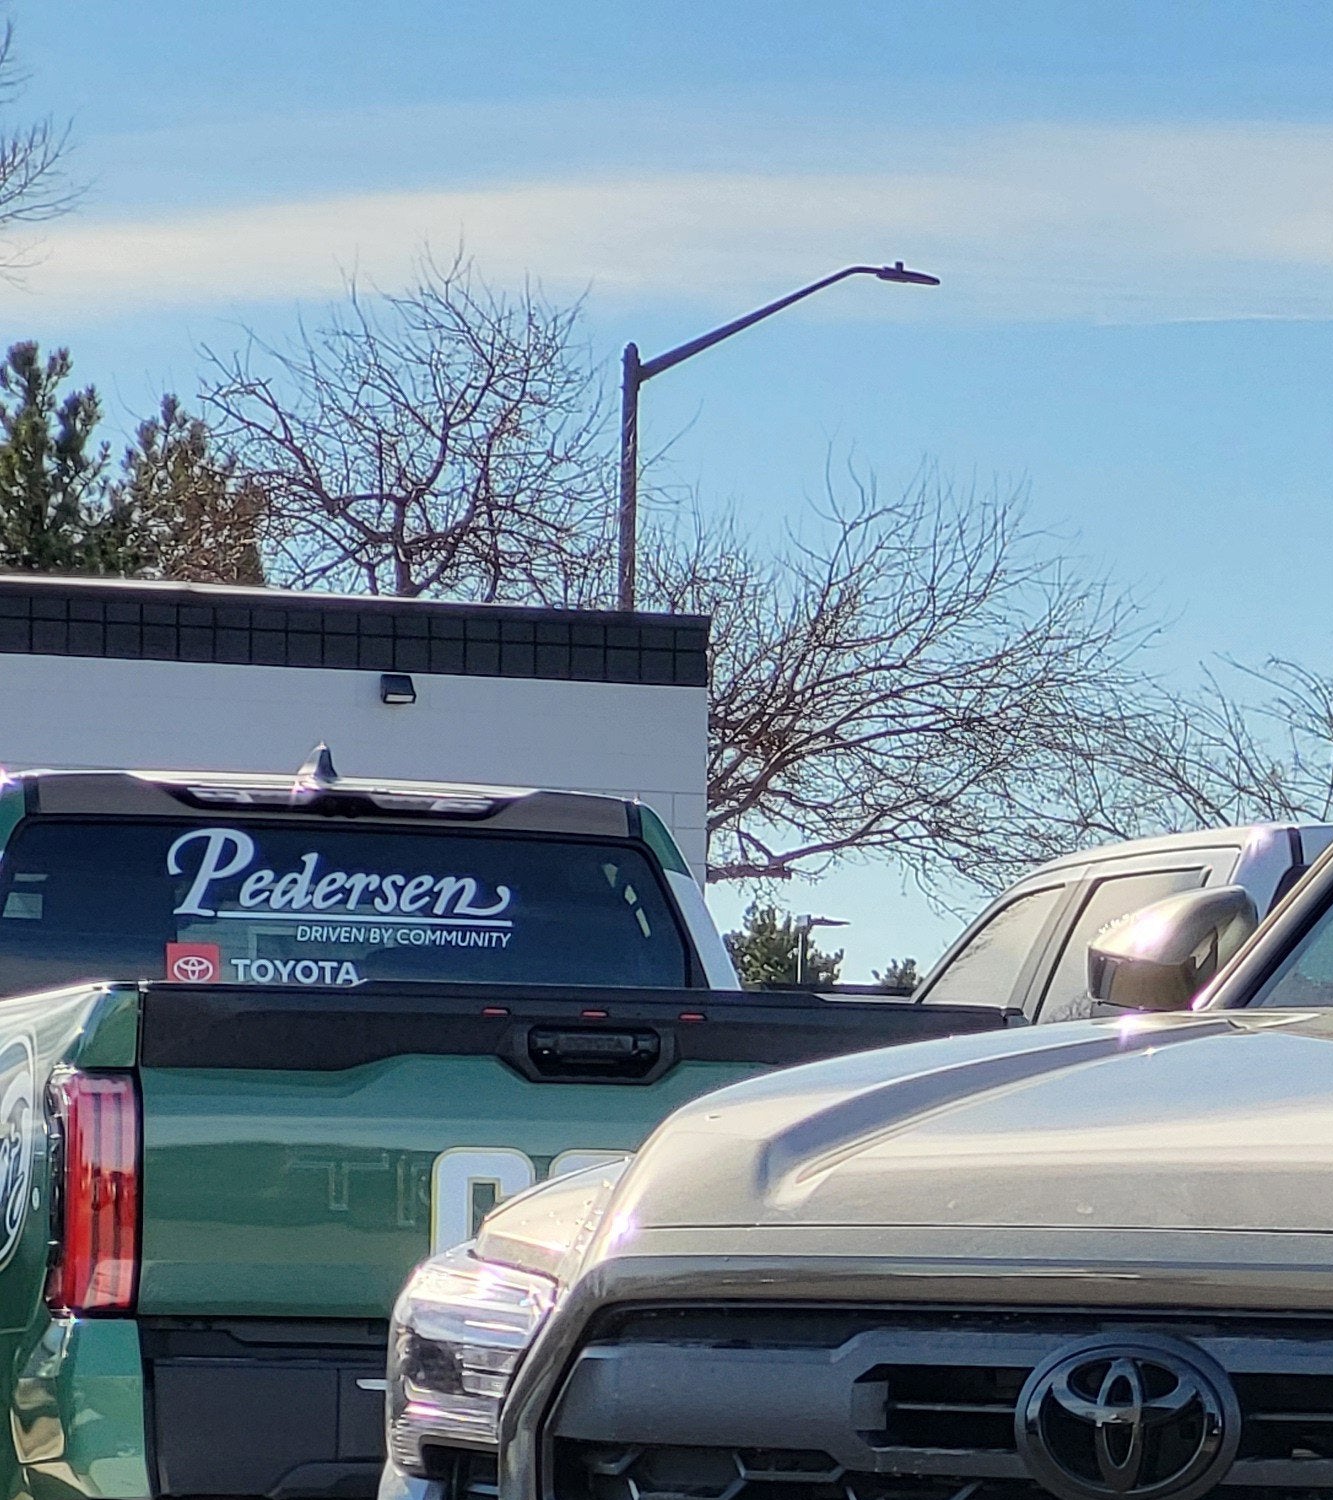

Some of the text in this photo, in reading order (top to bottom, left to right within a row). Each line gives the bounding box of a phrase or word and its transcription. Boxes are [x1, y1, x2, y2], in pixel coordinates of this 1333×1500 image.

[167, 827, 512, 917] Pedersen
[296, 925, 512, 948] DRIVEN BY COMMUNITY
[231, 957, 360, 985] TOYOTA
